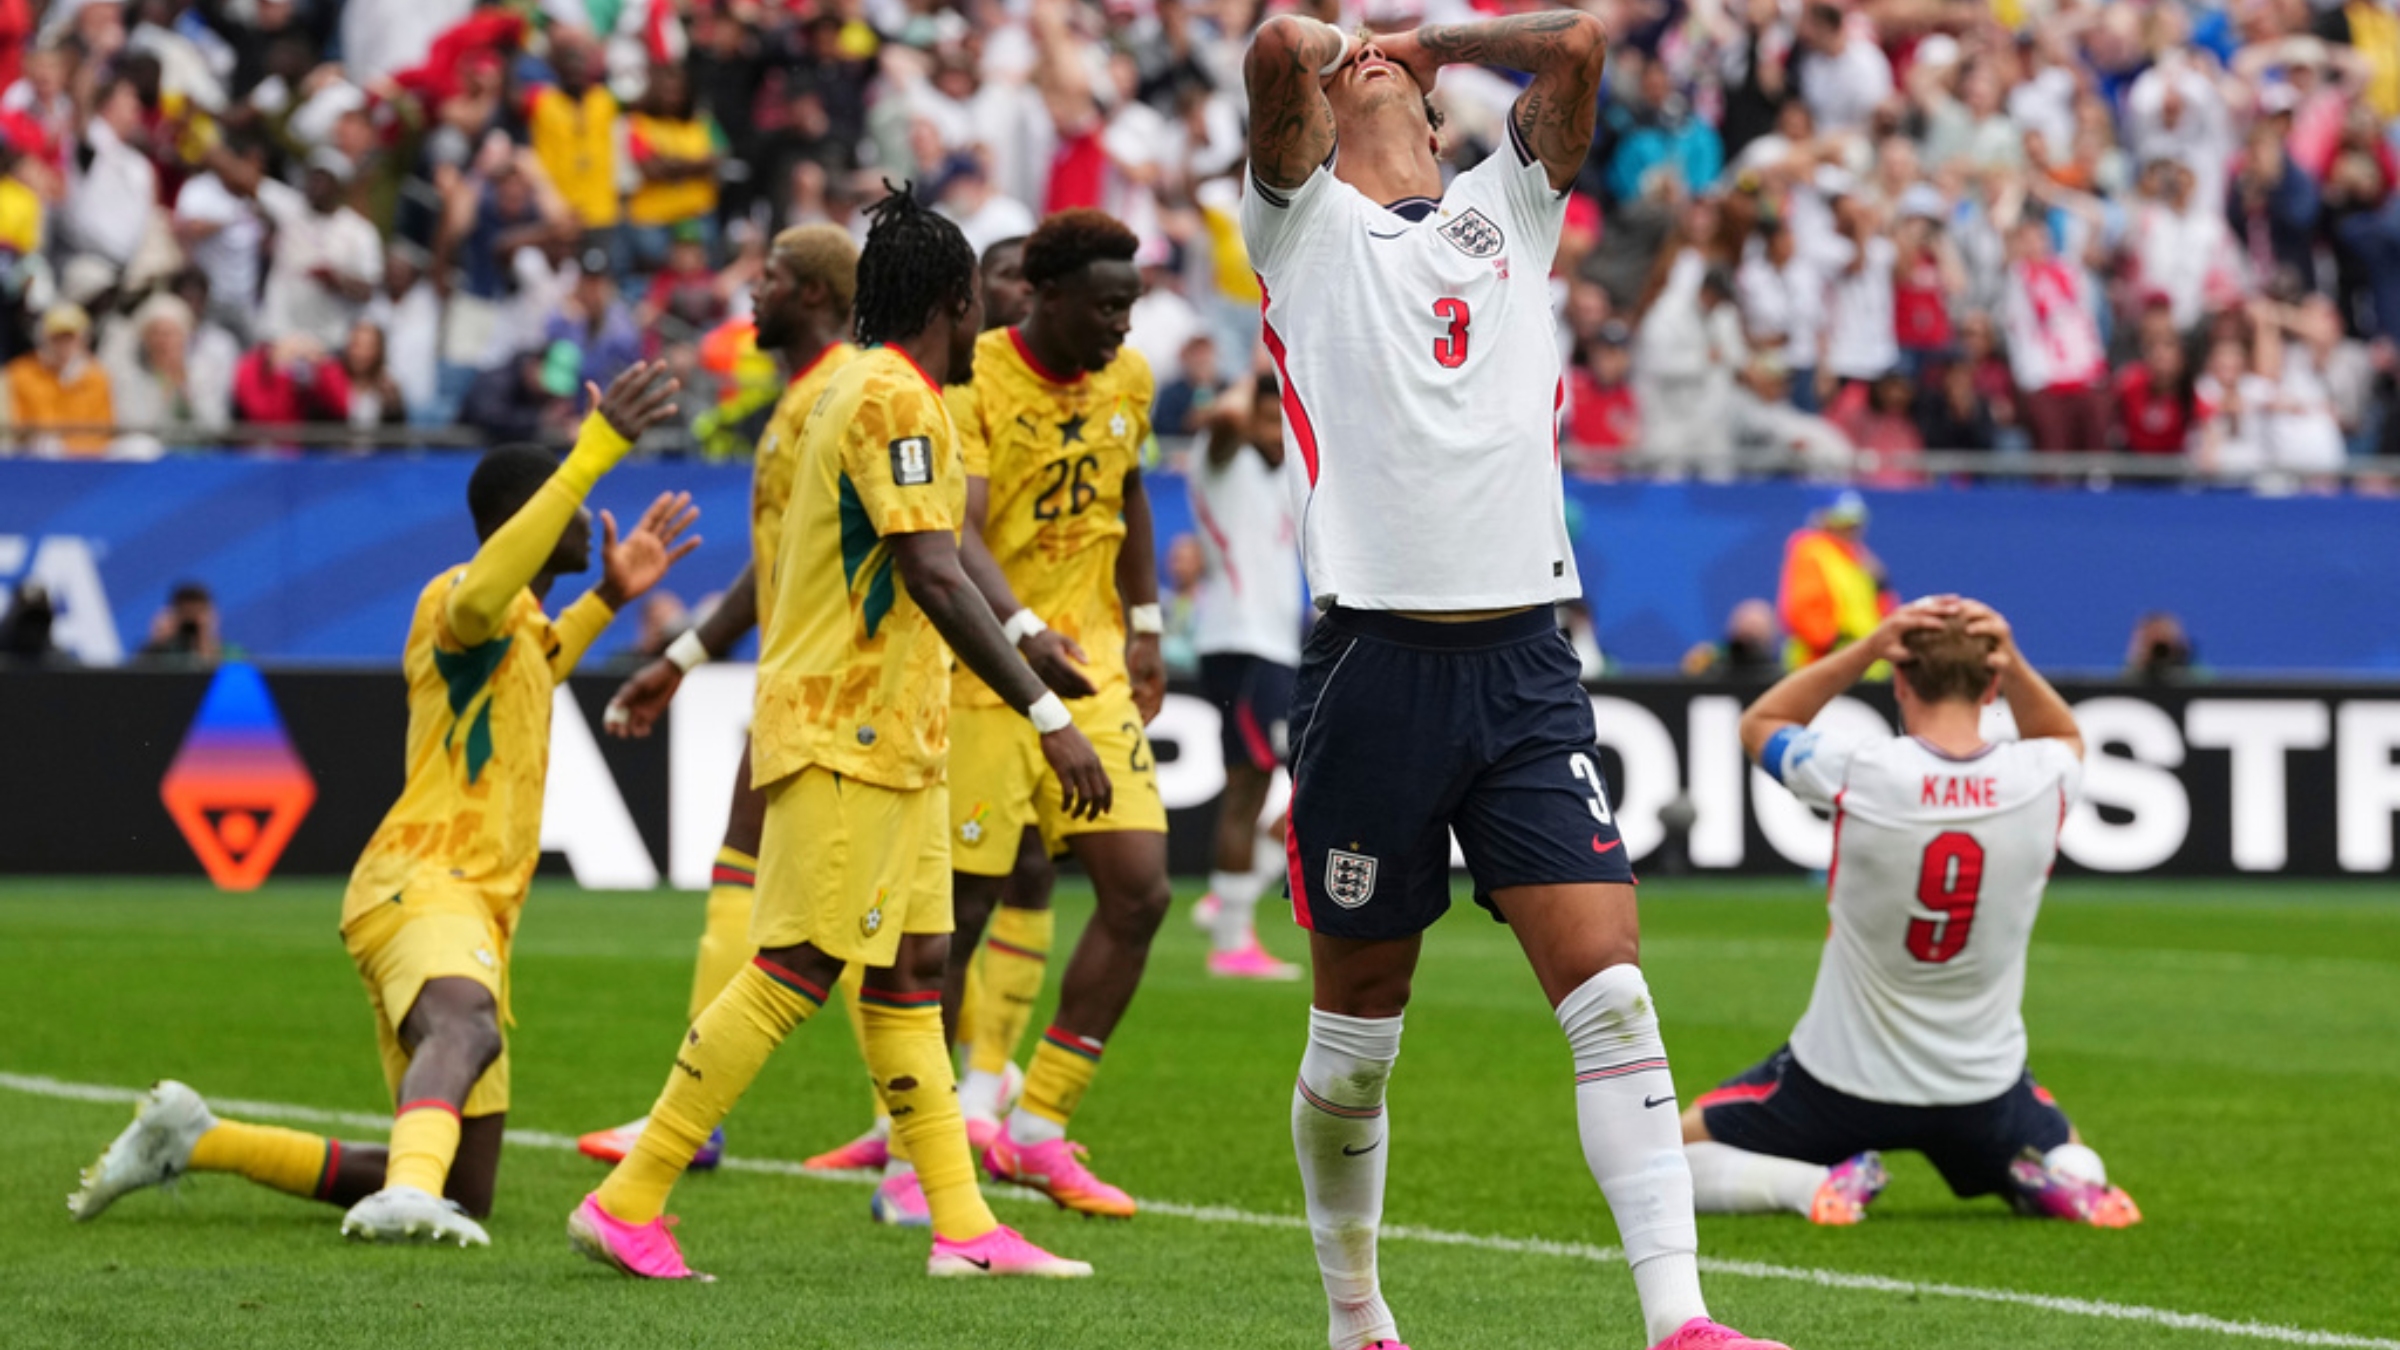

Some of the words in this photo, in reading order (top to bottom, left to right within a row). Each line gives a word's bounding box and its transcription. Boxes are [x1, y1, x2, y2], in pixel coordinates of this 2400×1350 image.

[1432, 297, 1470, 369] 3
[1034, 454, 1098, 520] 26
[1569, 752, 1611, 825] 3
[1921, 773, 1999, 808] KANE
[1904, 829, 1985, 965] 9
